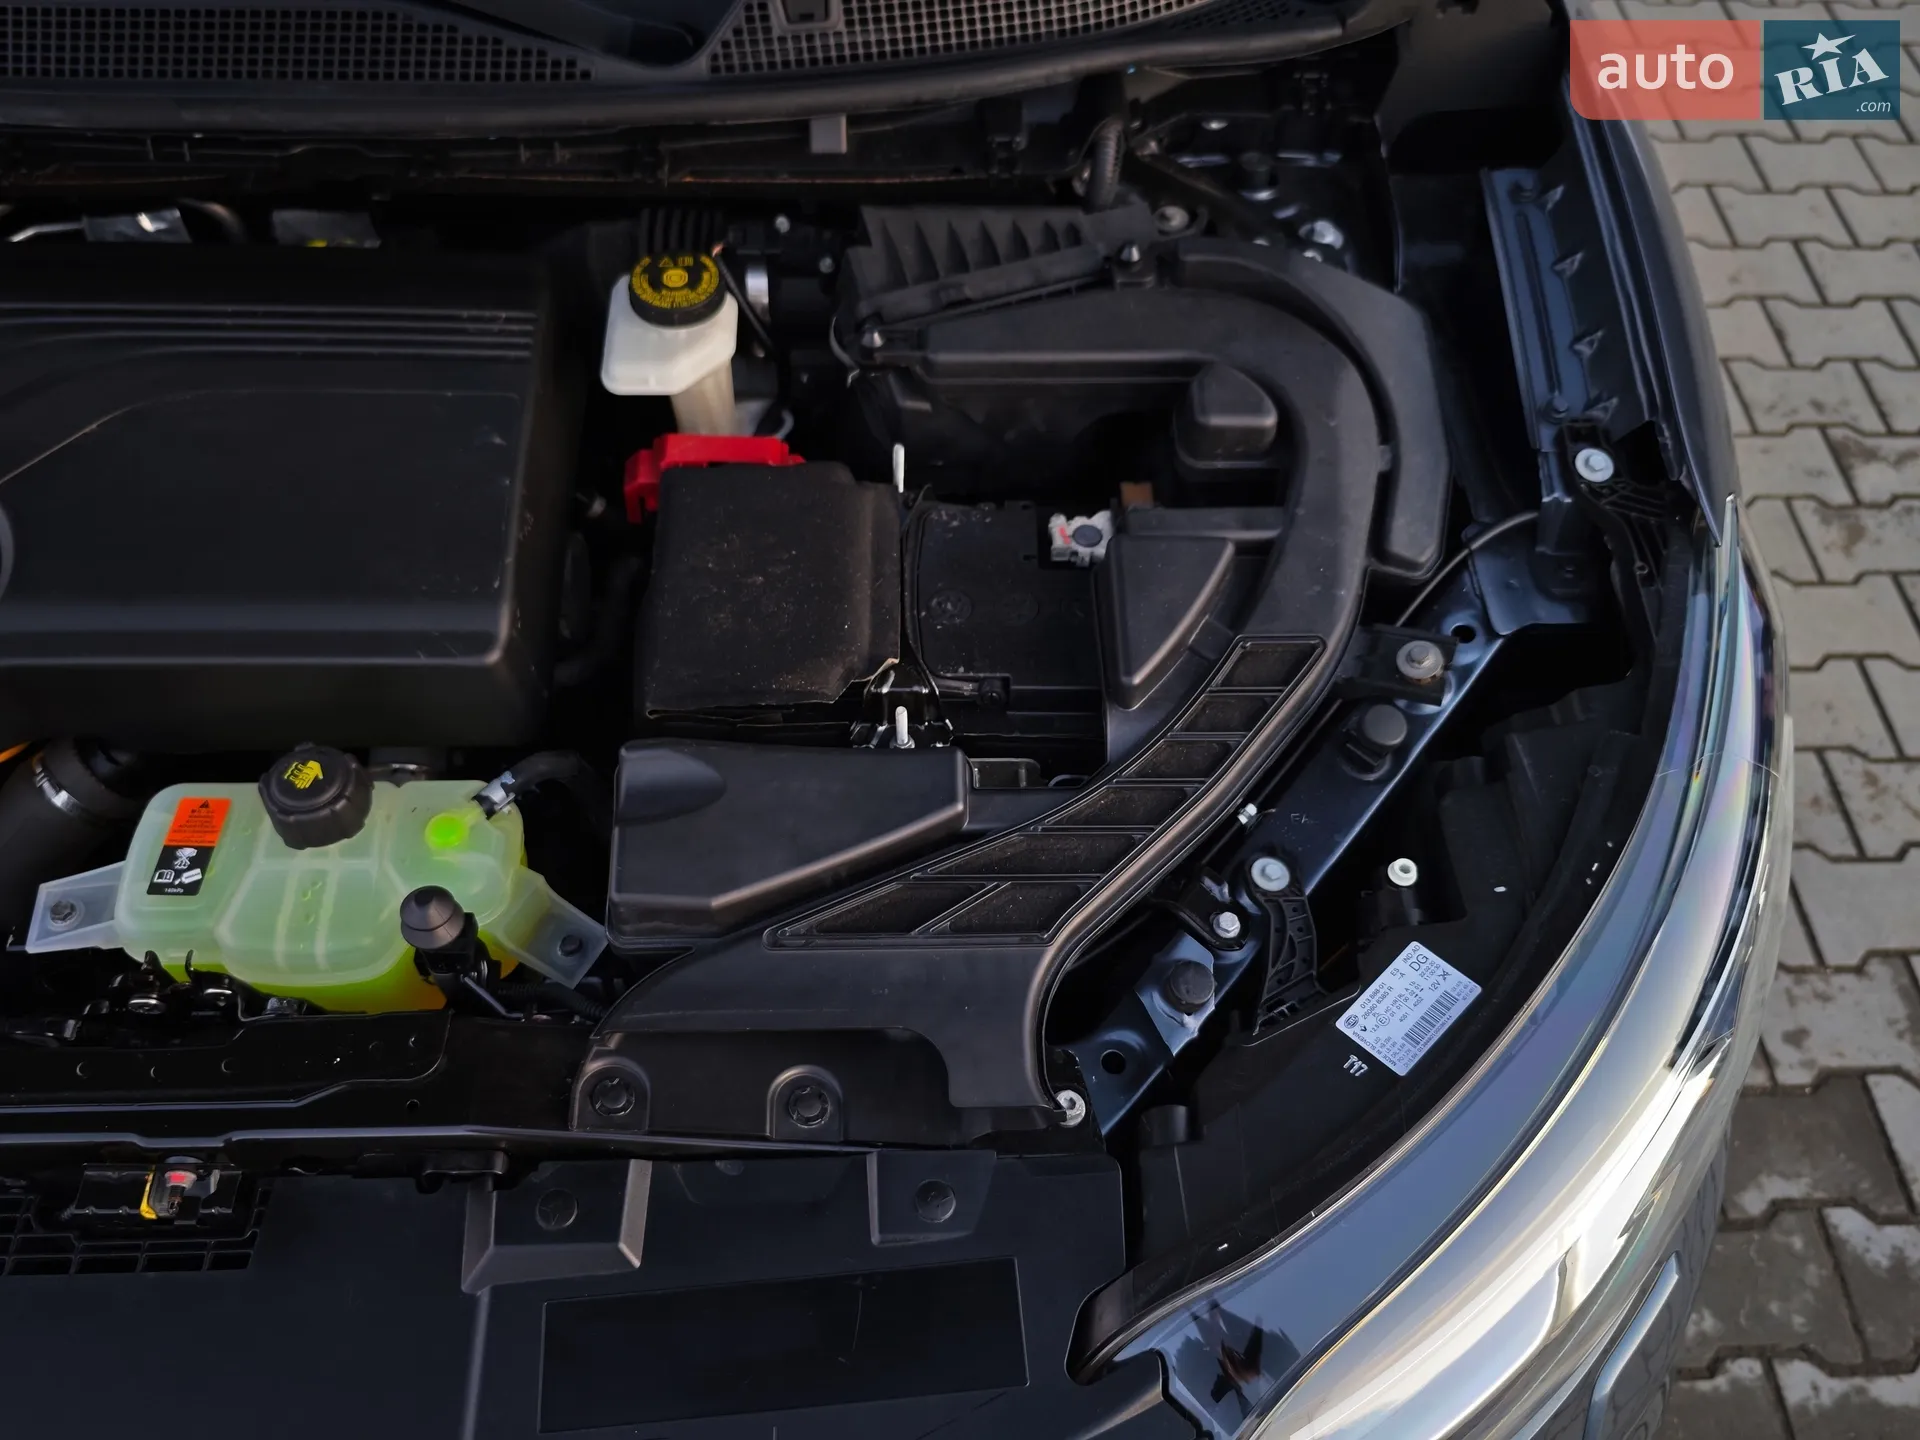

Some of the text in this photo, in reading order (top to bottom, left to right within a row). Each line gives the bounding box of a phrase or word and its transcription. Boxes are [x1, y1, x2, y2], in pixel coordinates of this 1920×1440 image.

[1408, 952, 1429, 972] DG
[1389, 966, 1400, 976] ES
[1427, 979, 1441, 992] 12V
[1360, 1002, 1378, 1019] 26060
[1351, 1030, 1376, 1051] SLOVENIA
[1343, 1054, 1369, 1077] T17
[1380, 1052, 1397, 1066] MADE
